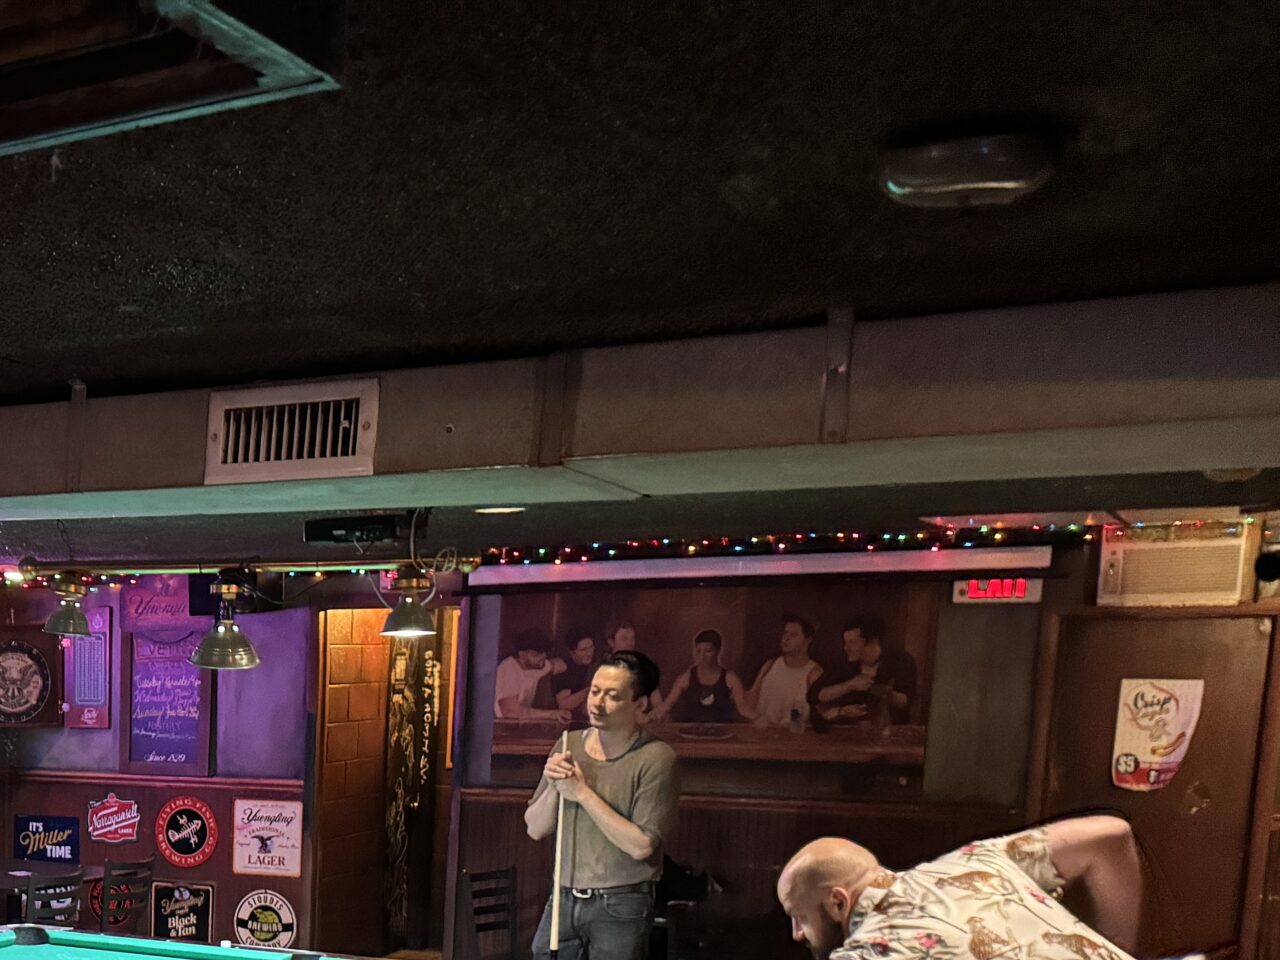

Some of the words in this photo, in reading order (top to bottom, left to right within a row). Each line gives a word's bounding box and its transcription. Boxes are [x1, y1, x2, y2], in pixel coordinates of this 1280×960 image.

[91, 803, 139, 833] Narragansett
[158, 799, 192, 826] FLYING
[195, 802, 214, 827] FISH
[240, 807, 297, 827] Yuengling
[28, 821, 44, 832] IT'S
[19, 829, 73, 855] Miller
[158, 834, 204, 864] BREWING
[45, 845, 73, 859] TIME
[247, 854, 286, 867] LAGER
[247, 895, 284, 911] STOUDTS
[167, 912, 197, 930] Black
[176, 924, 197, 937] Tan
